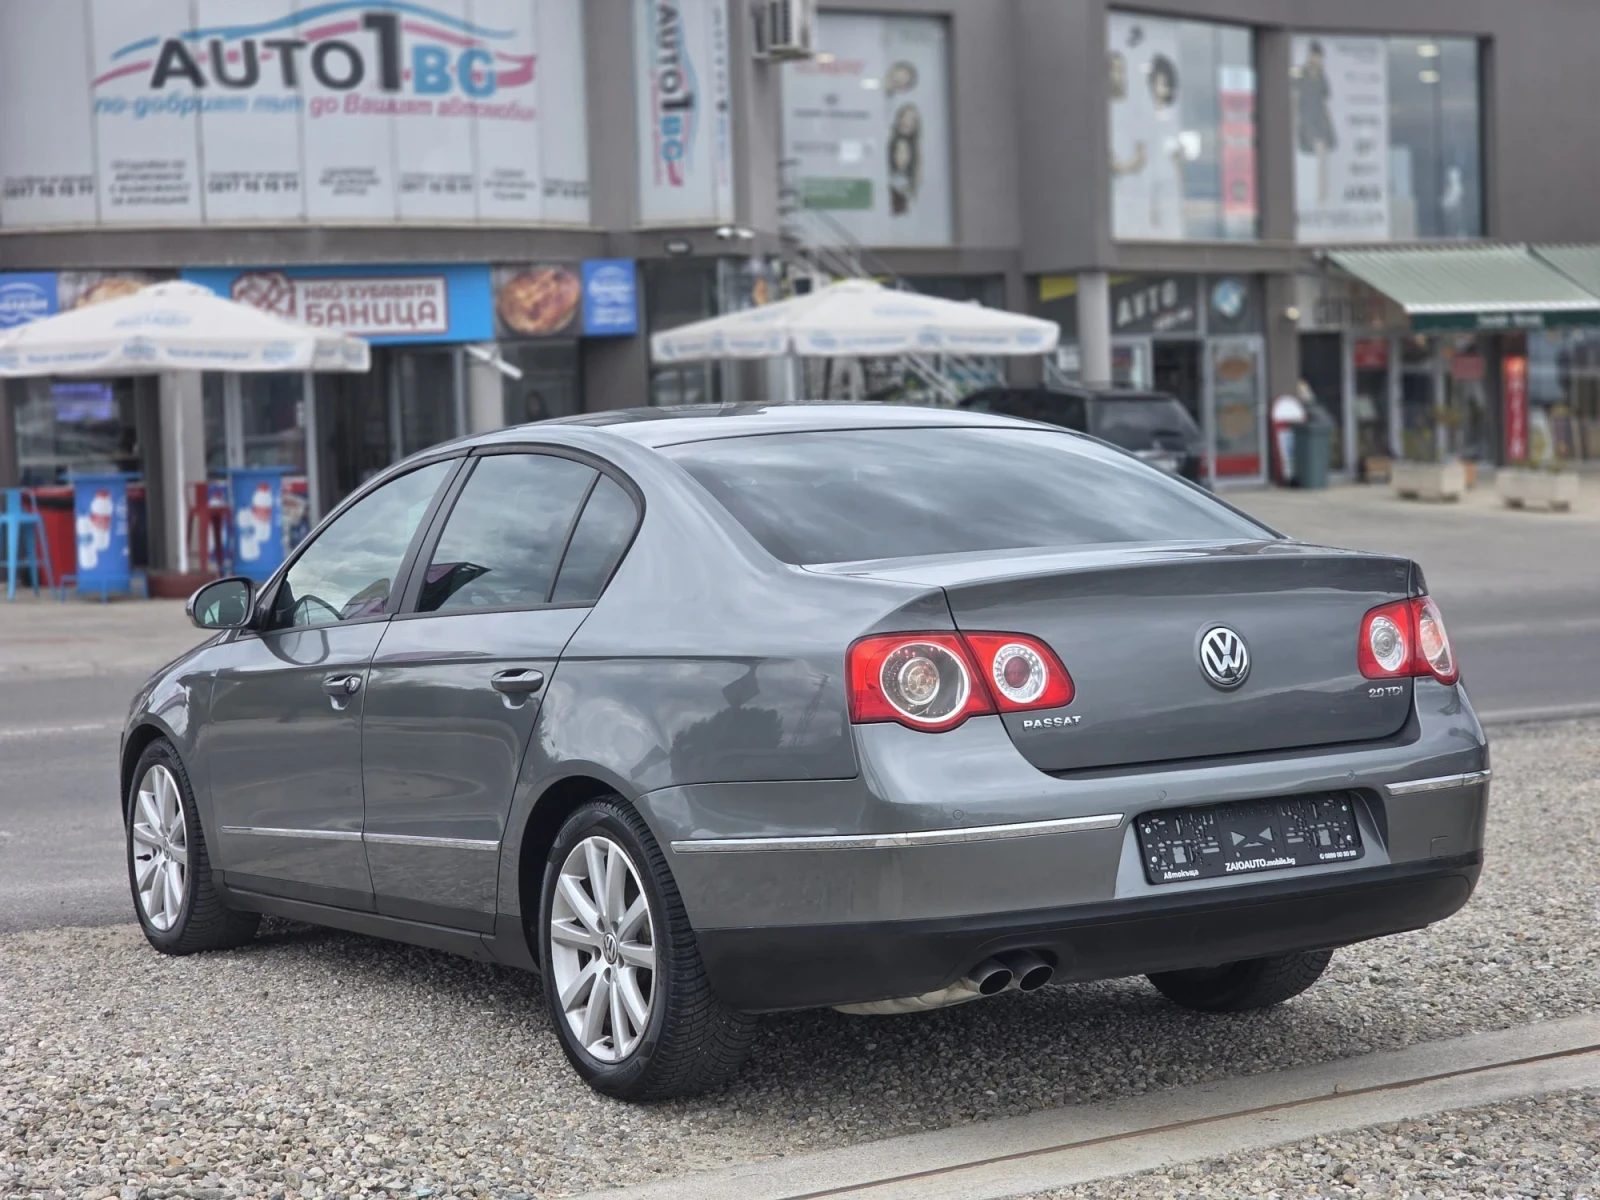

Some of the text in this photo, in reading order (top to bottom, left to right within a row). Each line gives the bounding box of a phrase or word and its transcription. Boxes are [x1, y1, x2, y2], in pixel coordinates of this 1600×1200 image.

[305, 300, 438, 328] БАНИЦА
[1201, 627, 1248, 684] VW
[1385, 685, 1404, 697] TDI
[1023, 715, 1081, 730] PASSAT
